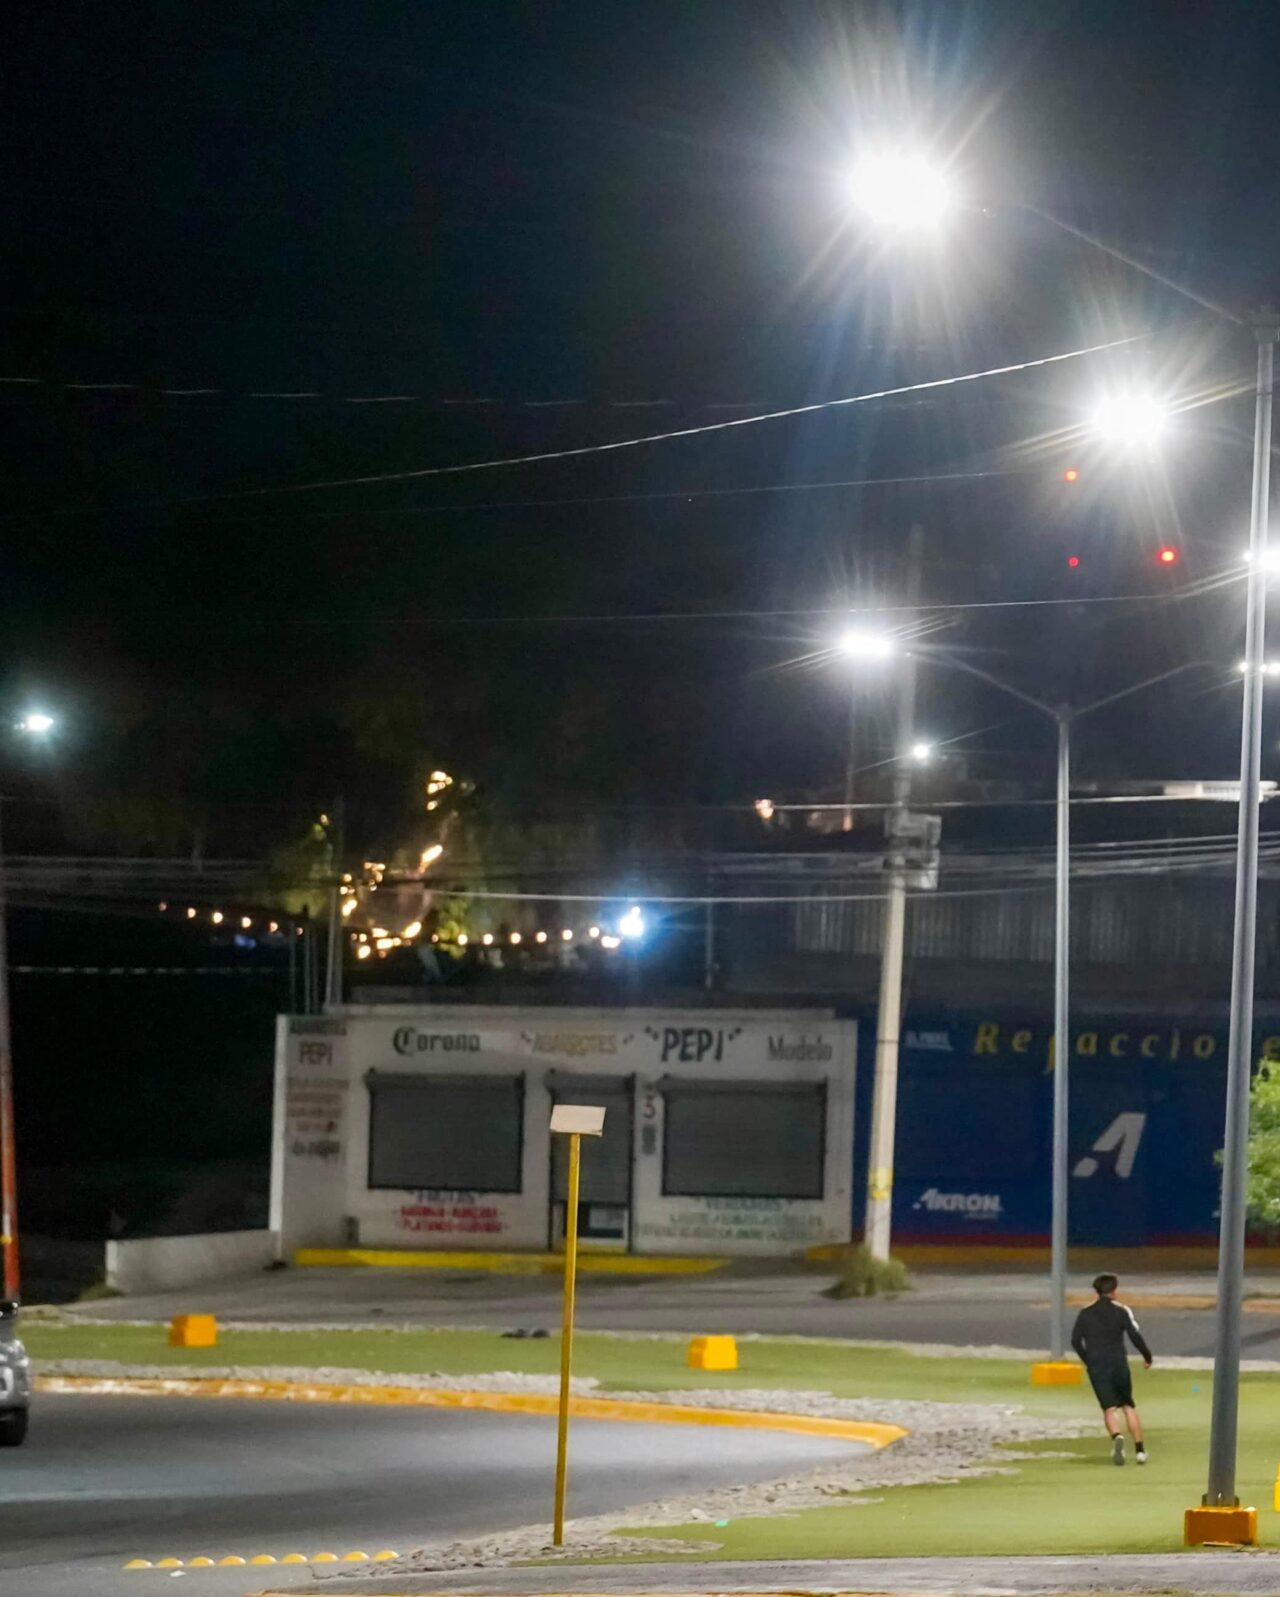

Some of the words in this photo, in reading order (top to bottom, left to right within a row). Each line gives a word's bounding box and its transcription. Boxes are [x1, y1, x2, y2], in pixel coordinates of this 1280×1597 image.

[391, 1025, 482, 1057] Corona
[767, 1034, 834, 1062] Modelo
[912, 1187, 1002, 1212] AKRON
